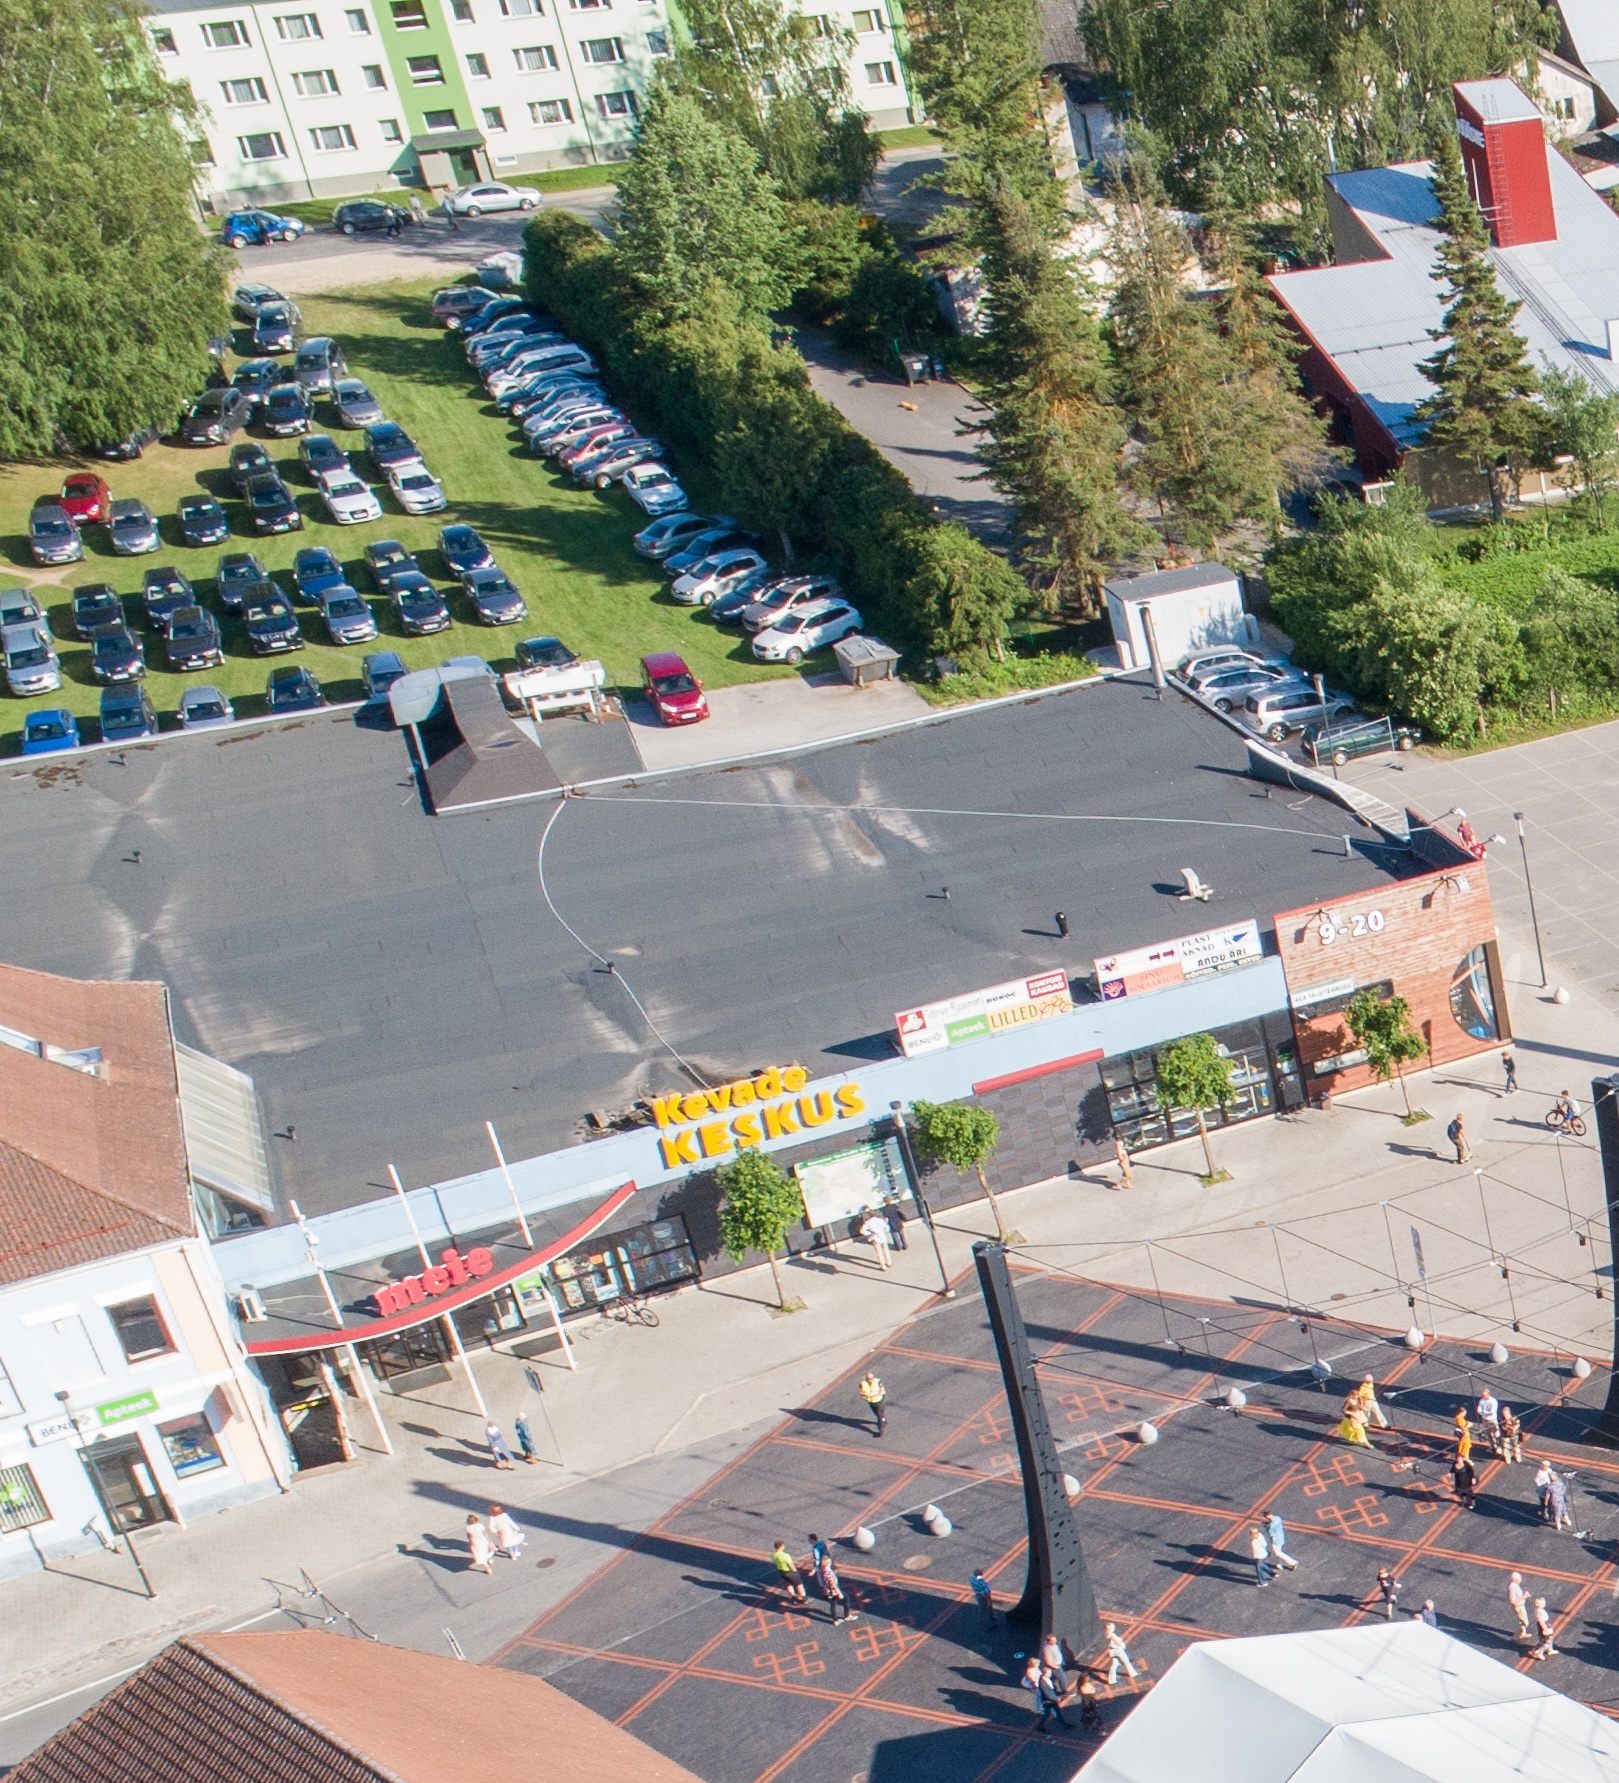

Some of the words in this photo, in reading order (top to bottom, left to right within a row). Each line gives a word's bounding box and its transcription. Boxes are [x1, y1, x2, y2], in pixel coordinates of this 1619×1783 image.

[1319, 910, 1384, 945] 9-20
[1197, 953, 1226, 967] ANDU
[990, 1004, 1038, 1028] LILLED
[652, 1065, 807, 1130] Kevade
[660, 1083, 866, 1169] KESKUS
[374, 1247, 494, 1318] meie
[103, 1397, 154, 1421] Apteek
